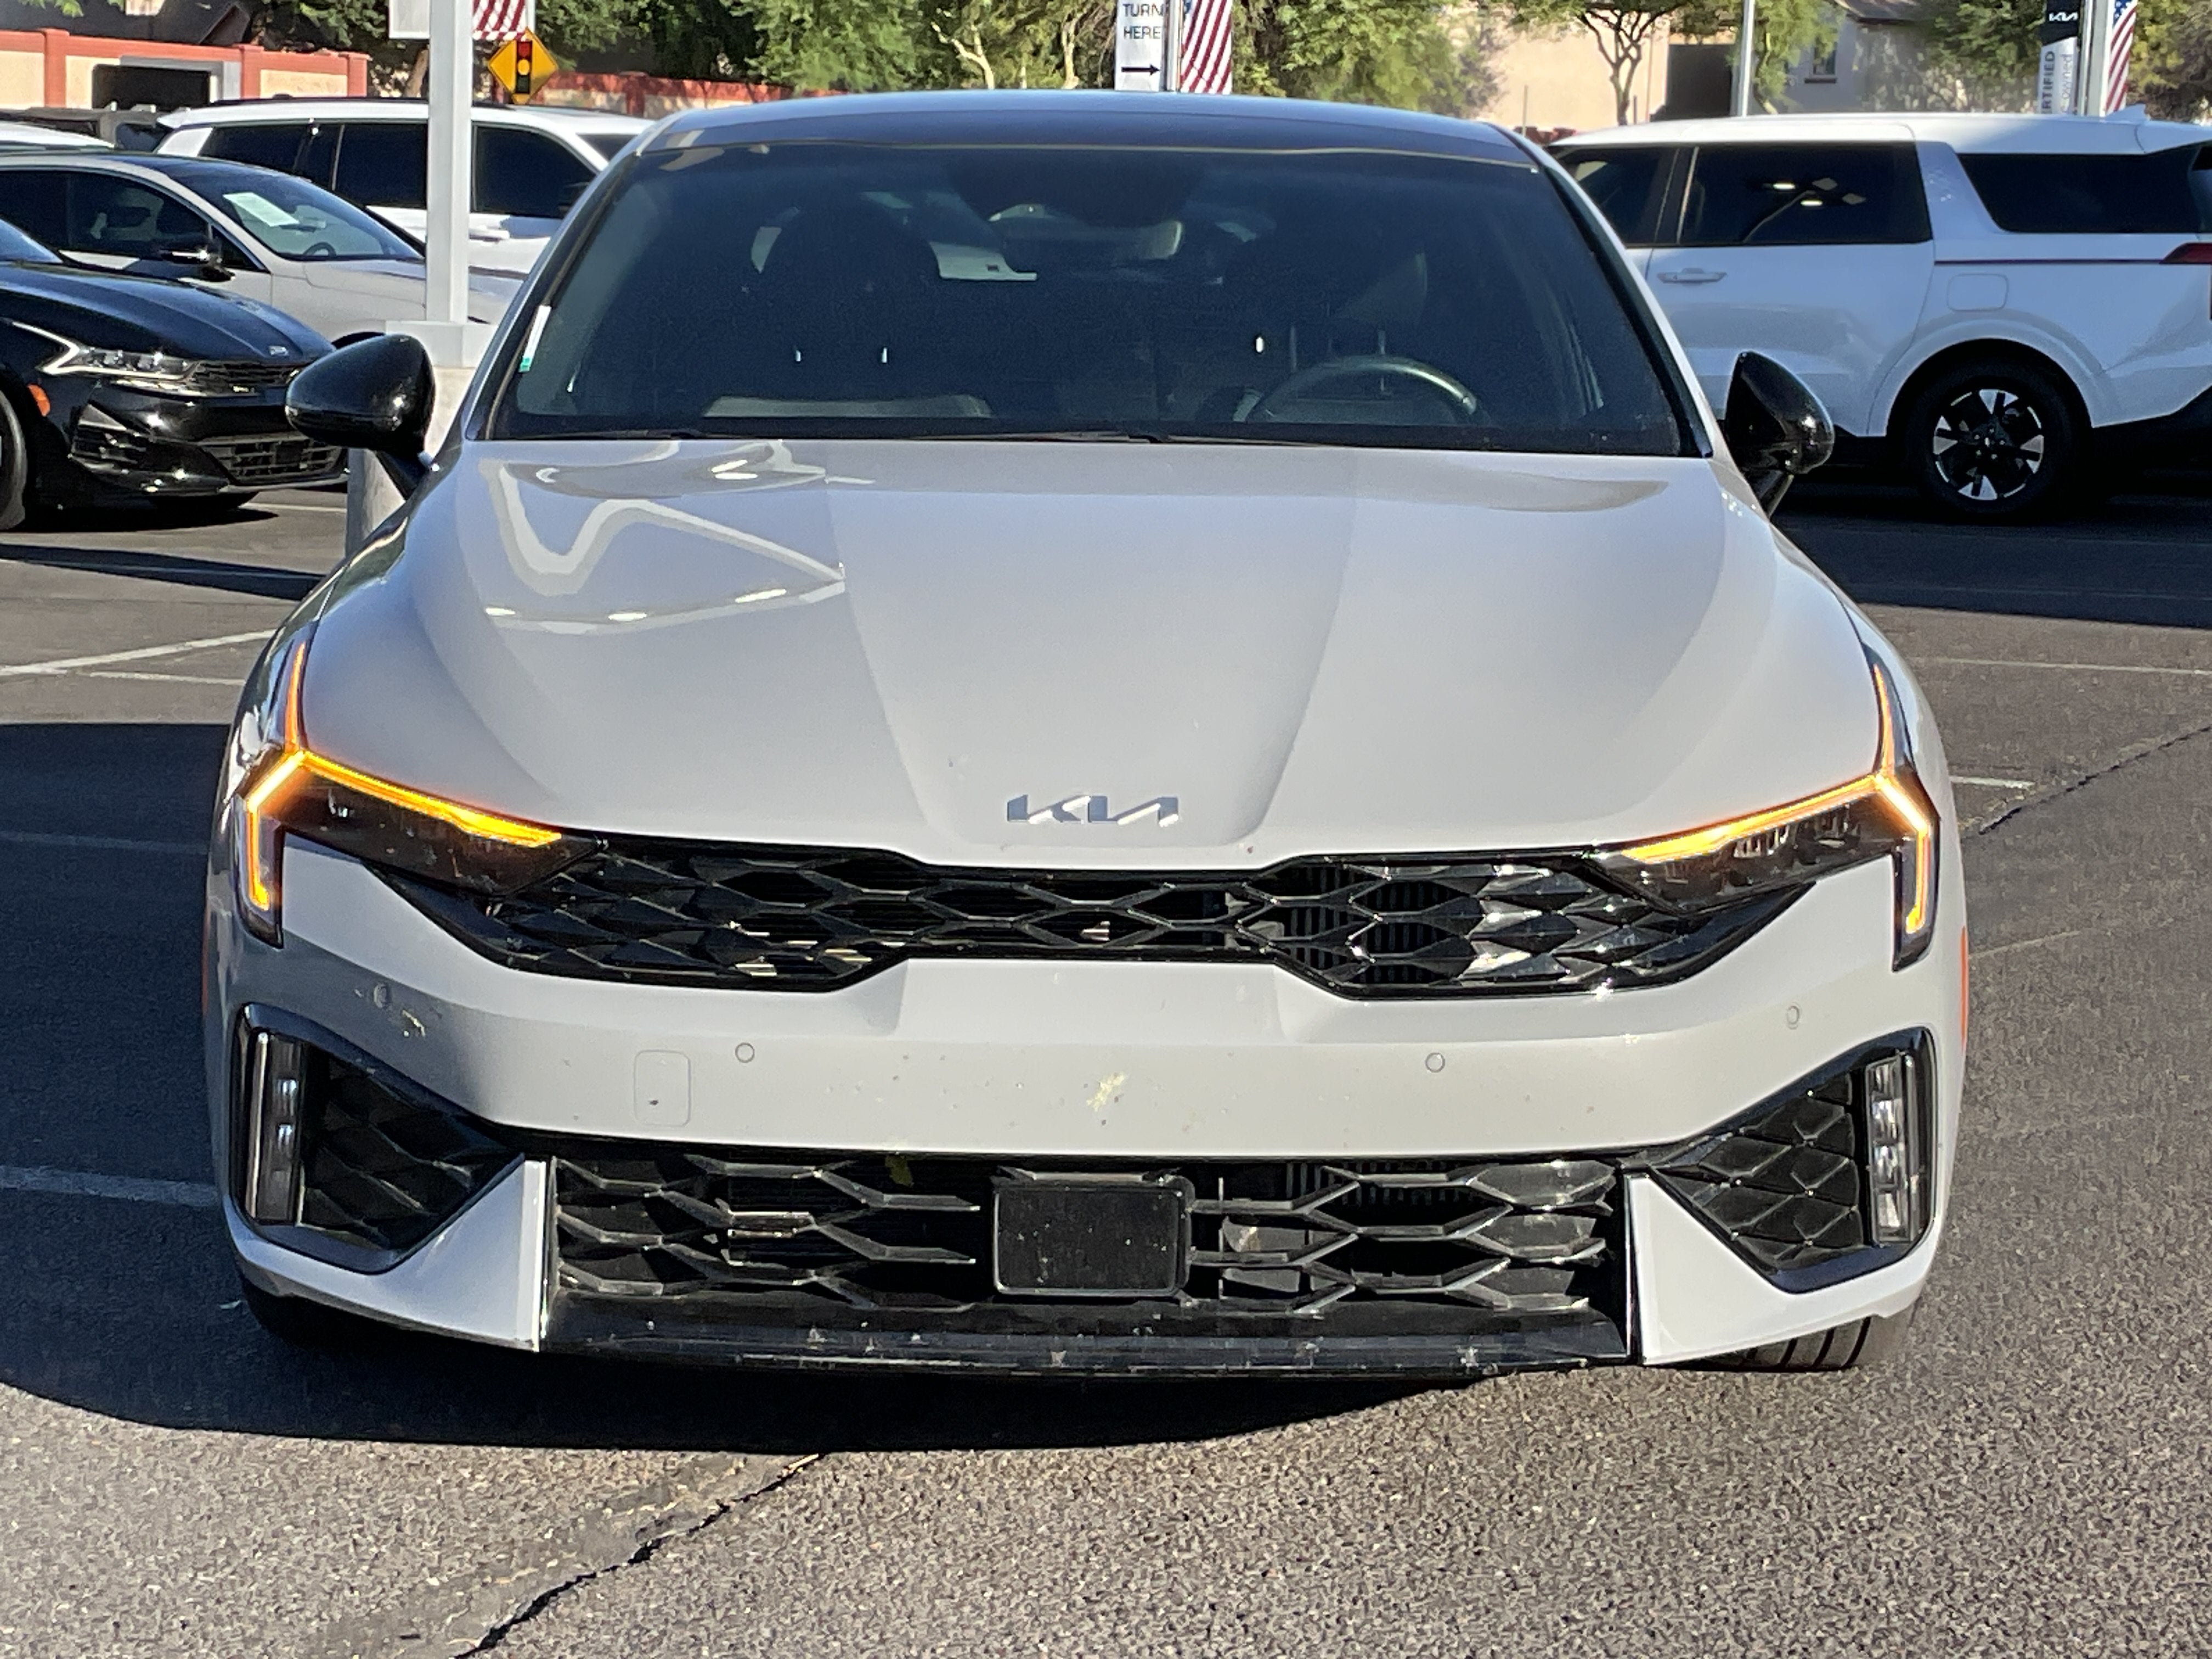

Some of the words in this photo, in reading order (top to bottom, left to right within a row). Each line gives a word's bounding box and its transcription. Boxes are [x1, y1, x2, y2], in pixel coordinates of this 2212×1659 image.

[1122, 3, 1165, 17] TURN
[2049, 12, 2078, 21] KIA
[1124, 26, 1161, 39] HERE
[1007, 794, 1178, 827] KIA
